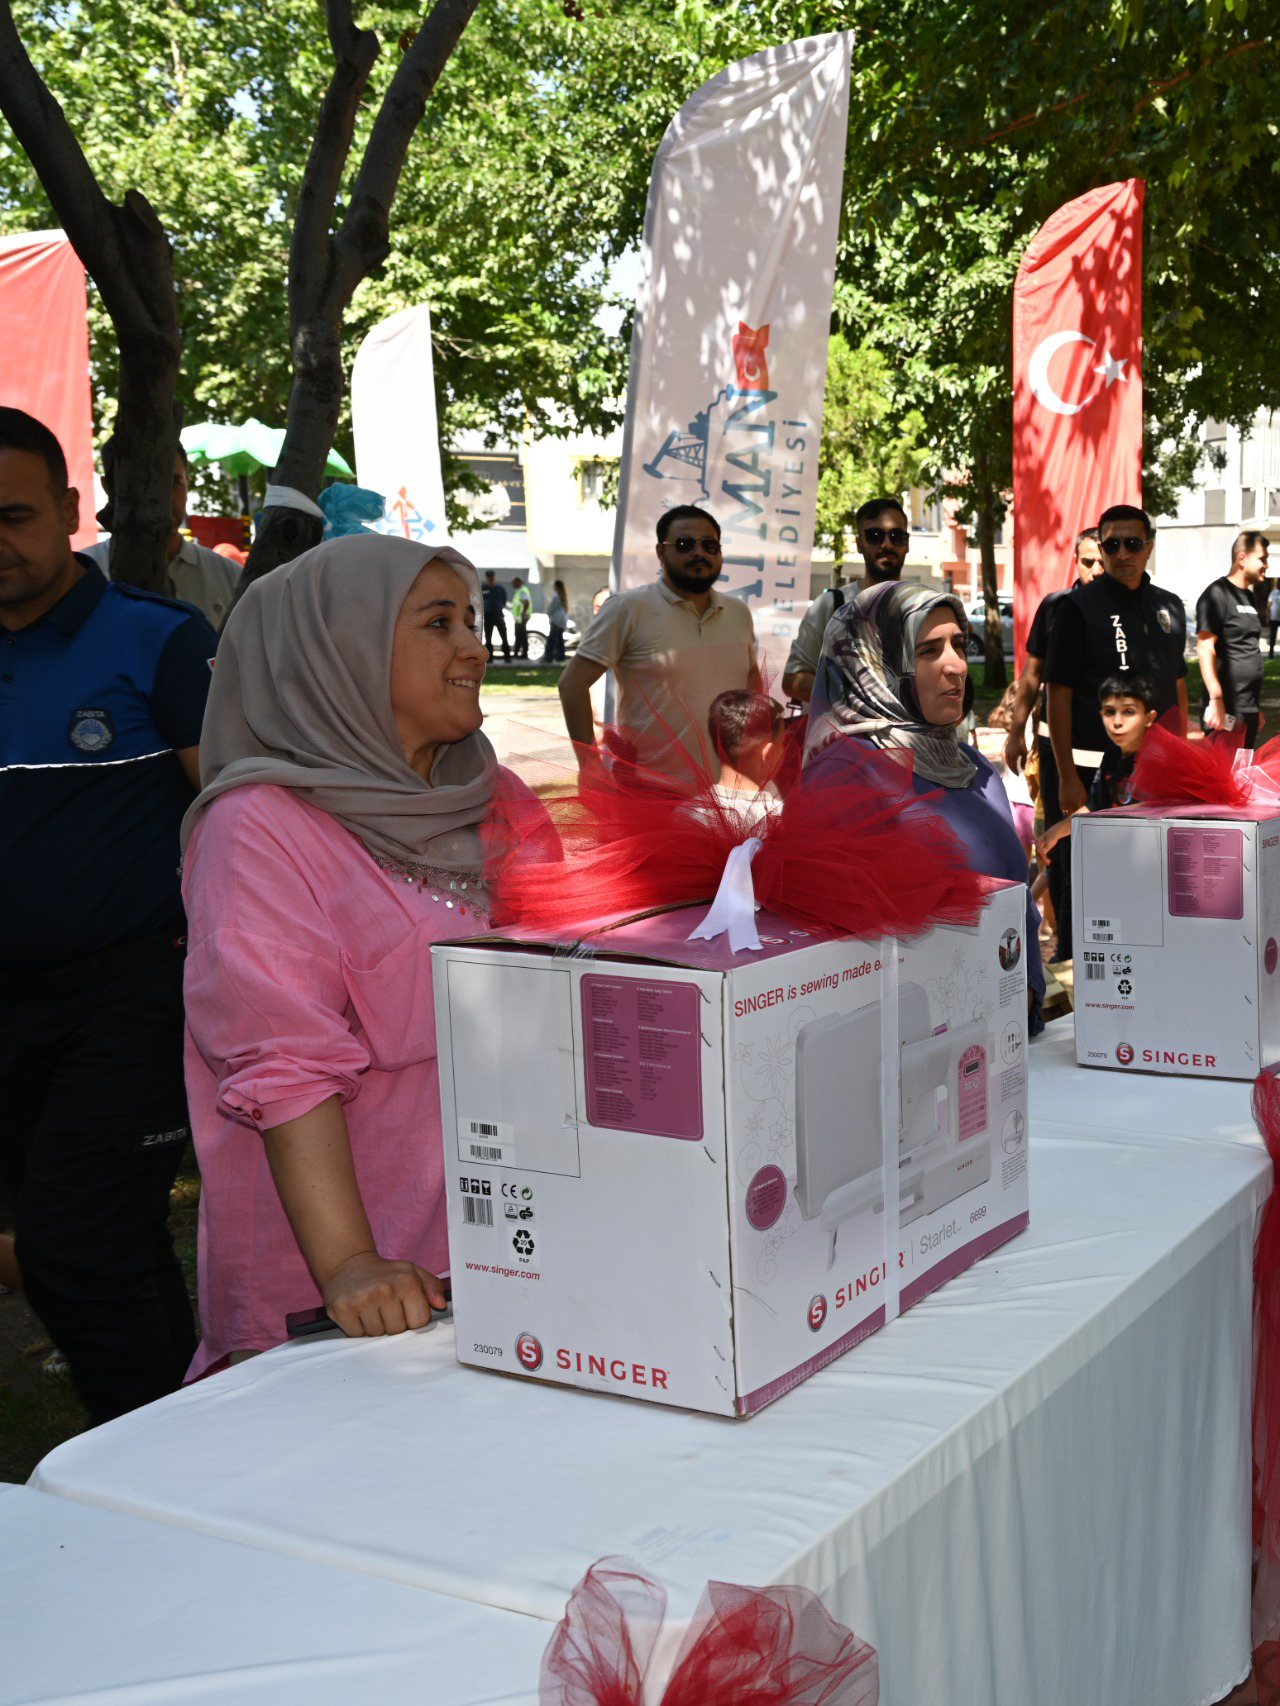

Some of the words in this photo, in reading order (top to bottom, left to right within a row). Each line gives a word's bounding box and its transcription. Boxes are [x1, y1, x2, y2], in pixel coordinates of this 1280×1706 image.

[771, 420, 807, 637] BELEDİYESİ
[734, 987, 785, 1017] SINGER
[787, 984, 797, 1000] is
[800, 974, 839, 996] sewing
[842, 960, 872, 982] made
[1085, 1002, 1135, 1010] www.singer.com
[1142, 1049, 1217, 1067] SINGER
[465, 1262, 541, 1281] www.singer.com
[835, 1251, 905, 1309] SINGR
[969, 1205, 987, 1224] 6699
[473, 1343, 503, 1357] 230079
[556, 1348, 669, 1390] SINGER
